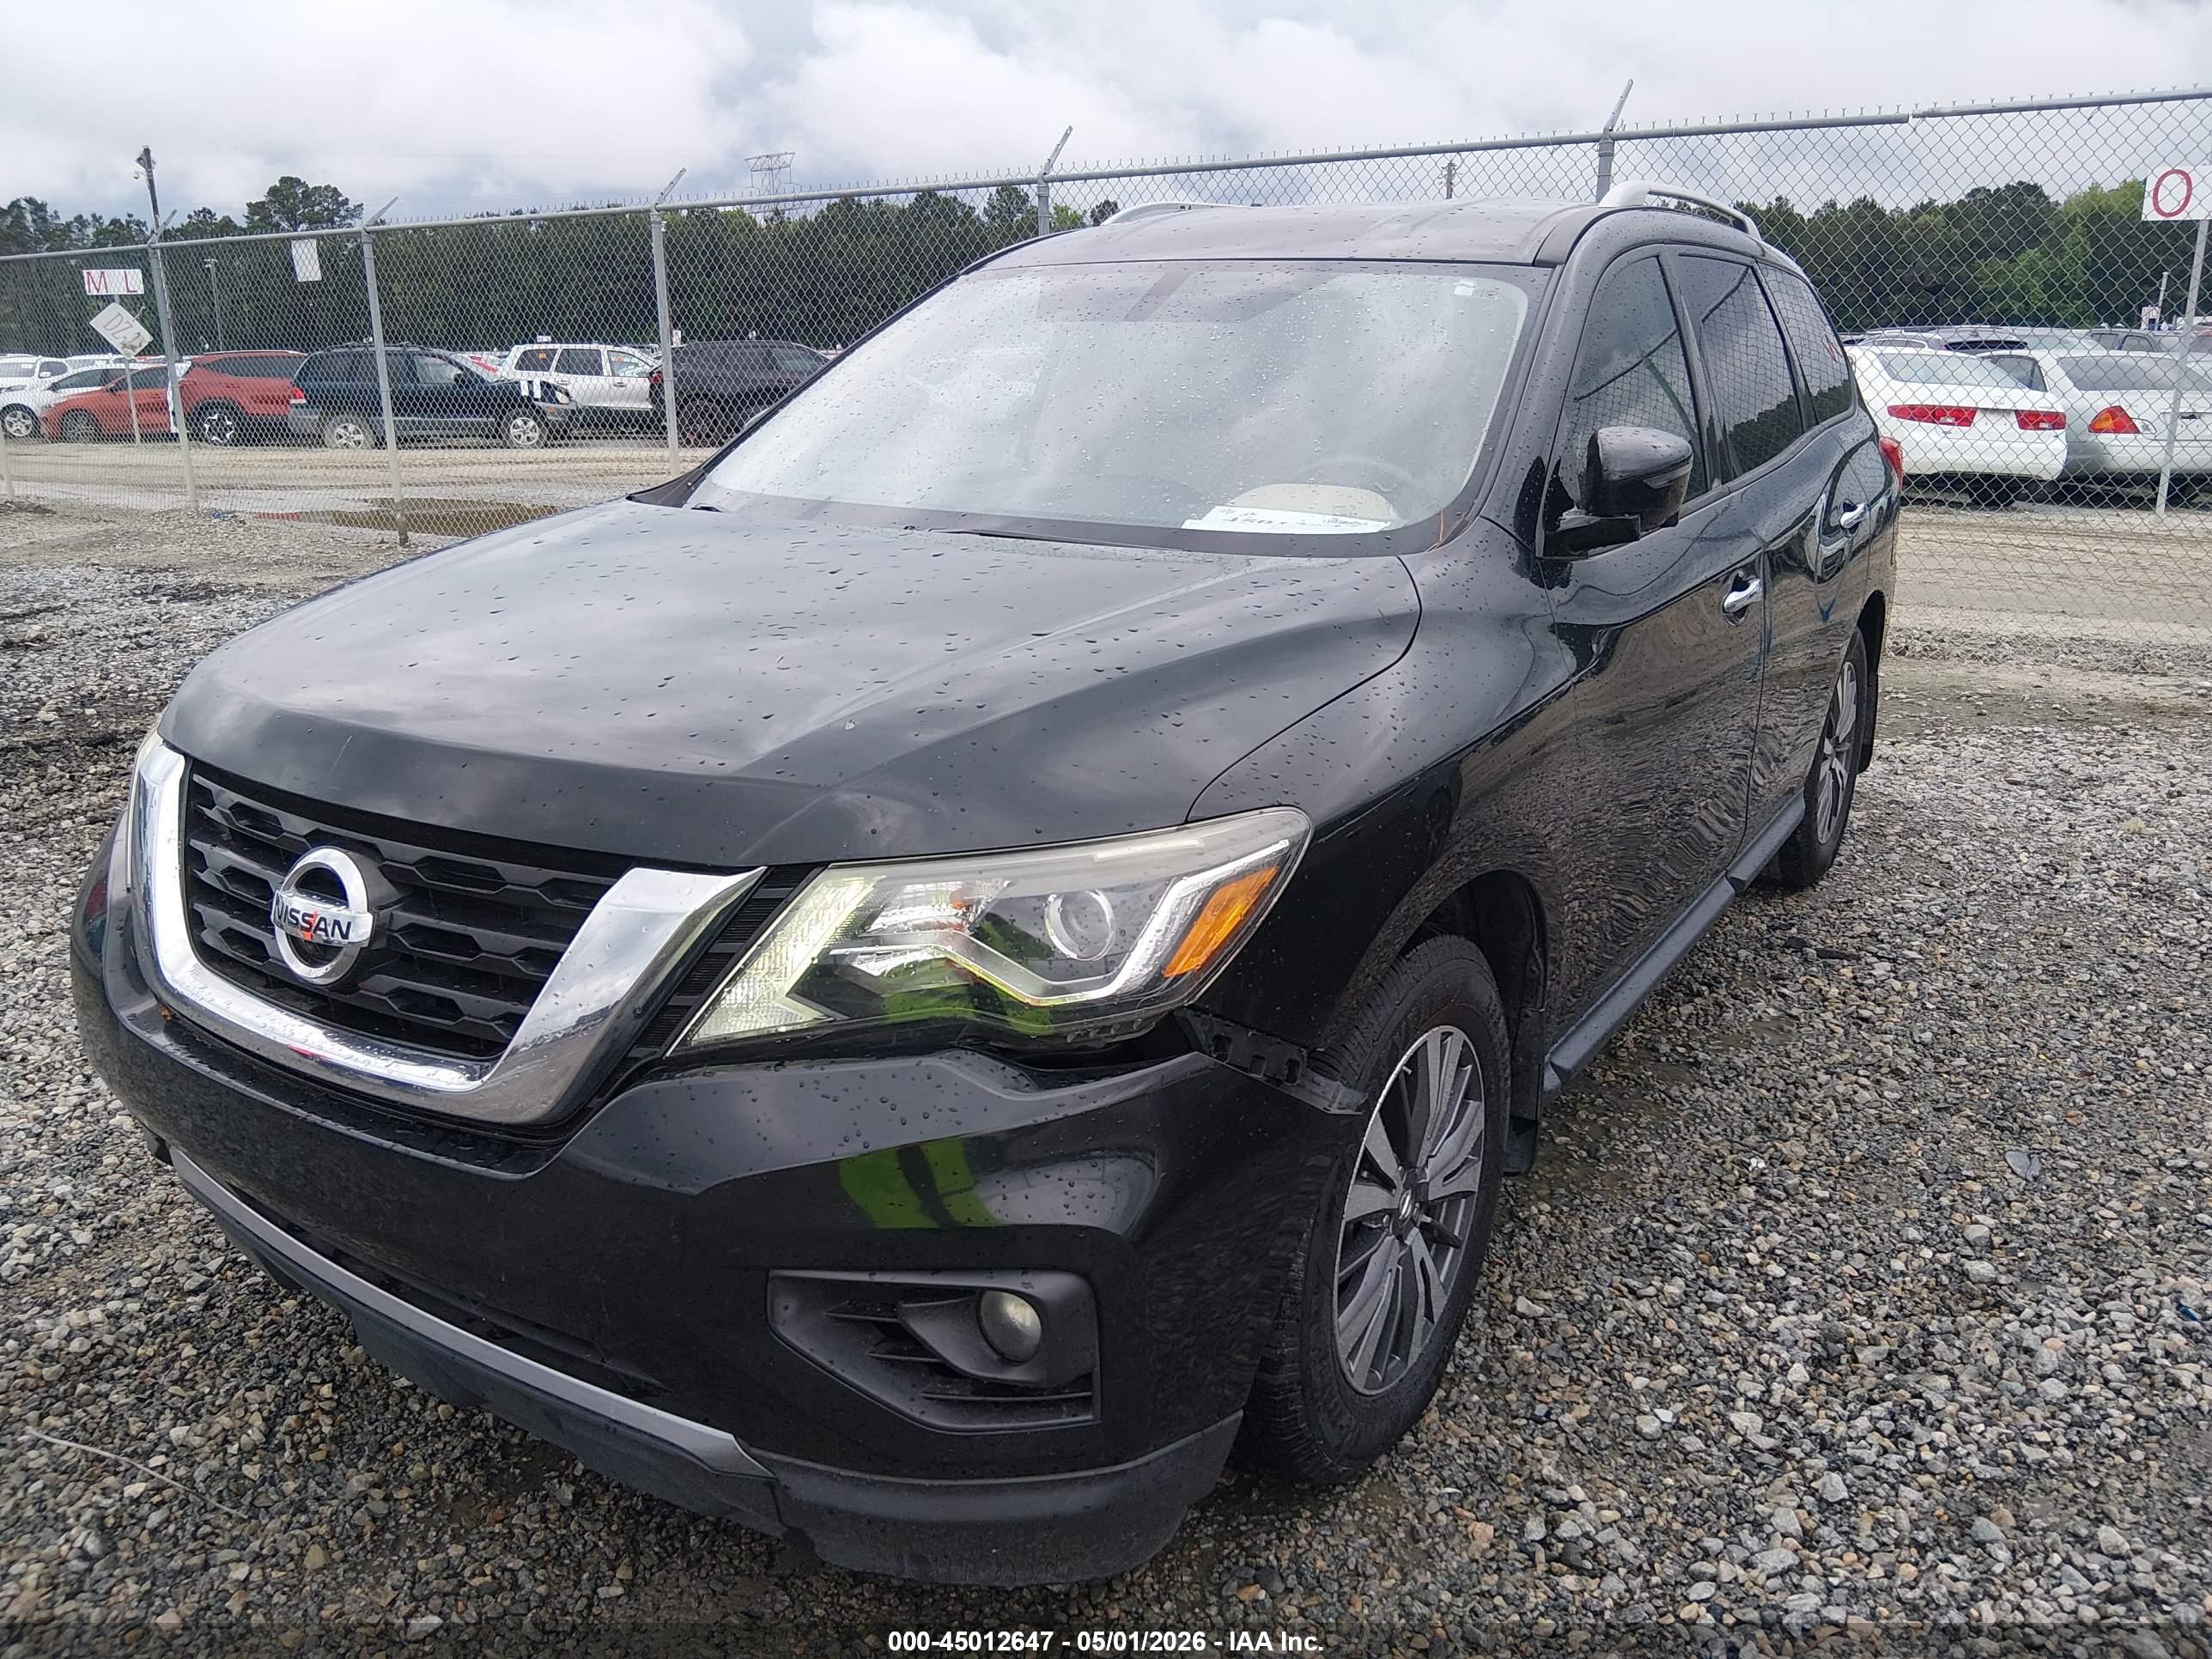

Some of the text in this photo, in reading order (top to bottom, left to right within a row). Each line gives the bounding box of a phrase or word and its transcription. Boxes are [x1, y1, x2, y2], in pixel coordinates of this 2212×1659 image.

[86, 270, 137, 293] M L
[273, 893, 352, 940] NISSAN
